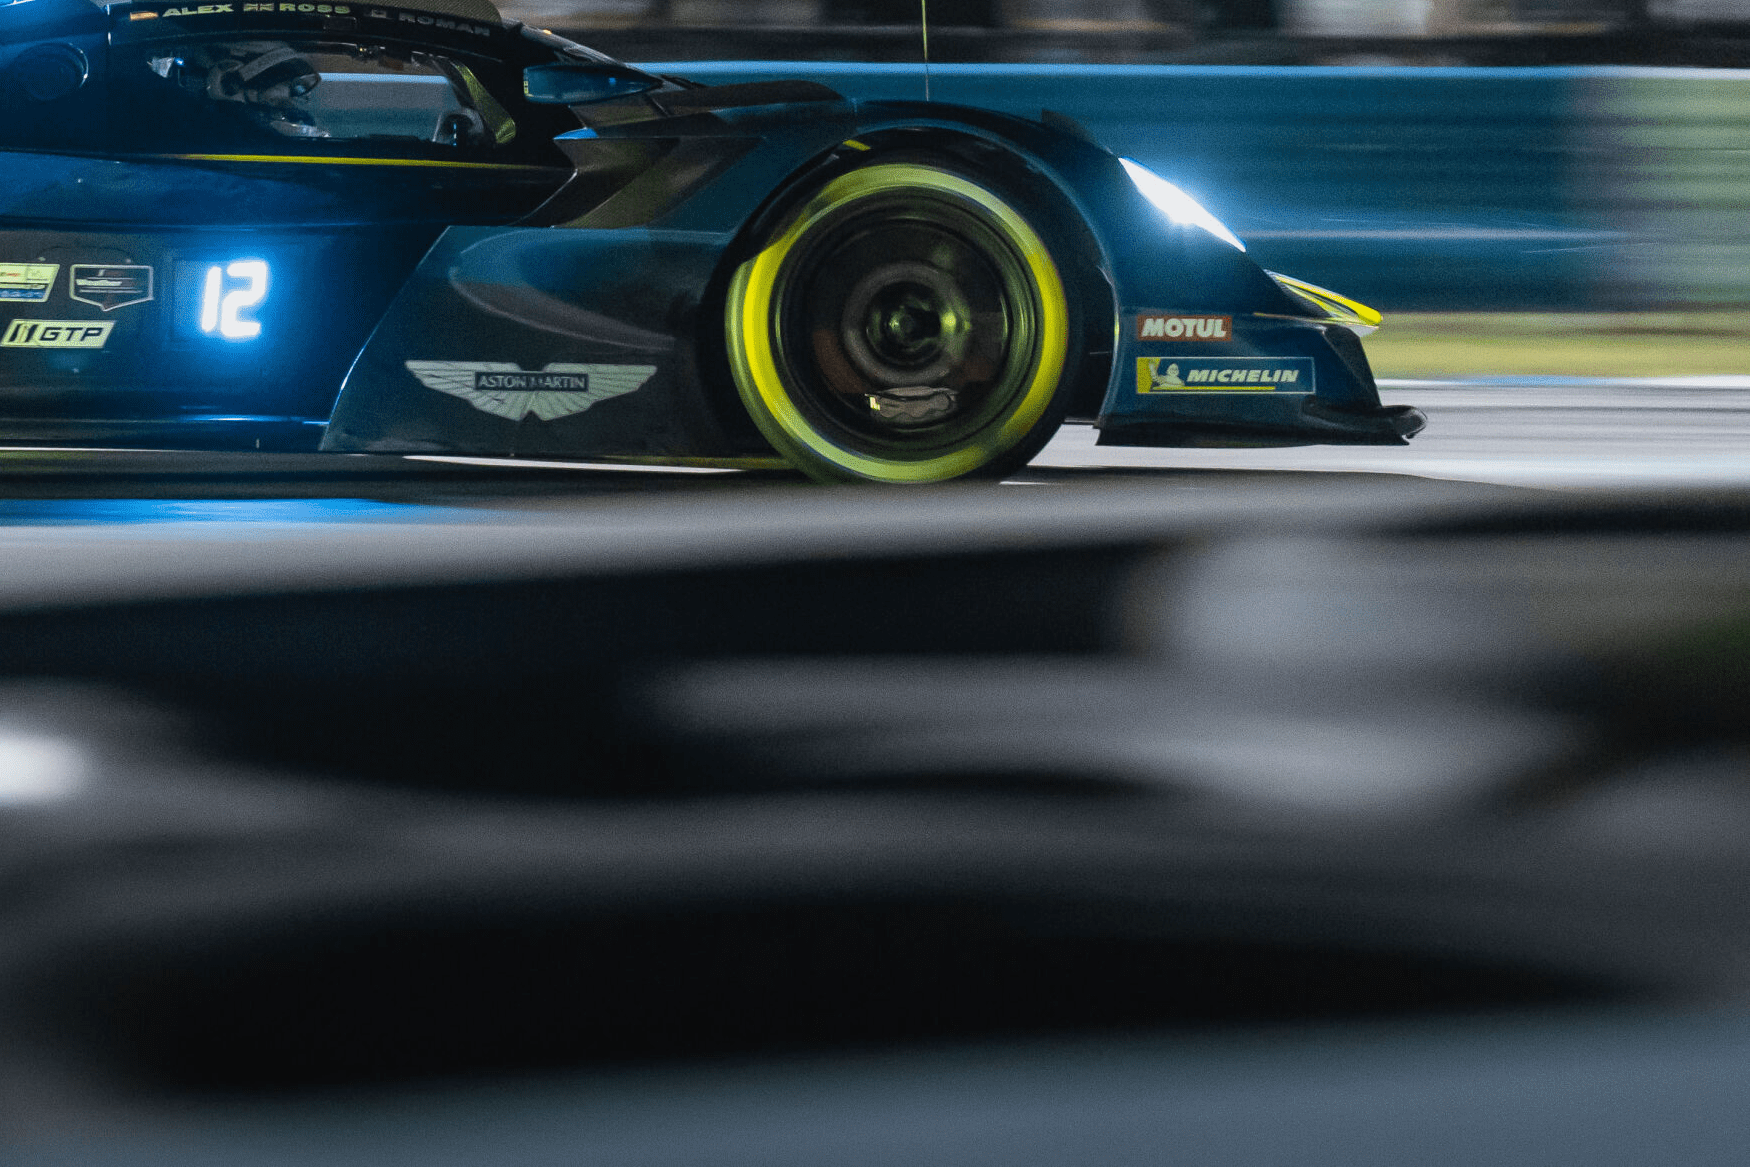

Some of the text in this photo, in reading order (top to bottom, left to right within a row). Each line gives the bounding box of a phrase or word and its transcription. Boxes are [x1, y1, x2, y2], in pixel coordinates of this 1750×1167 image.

[162, 3, 234, 18] ALEX
[279, 3, 351, 14] ROSS
[200, 259, 269, 339] 12
[39, 326, 104, 342] GTP
[1141, 317, 1228, 338] MOTUL
[479, 375, 526, 388] ASTON
[1187, 368, 1299, 384] MICHELIN
